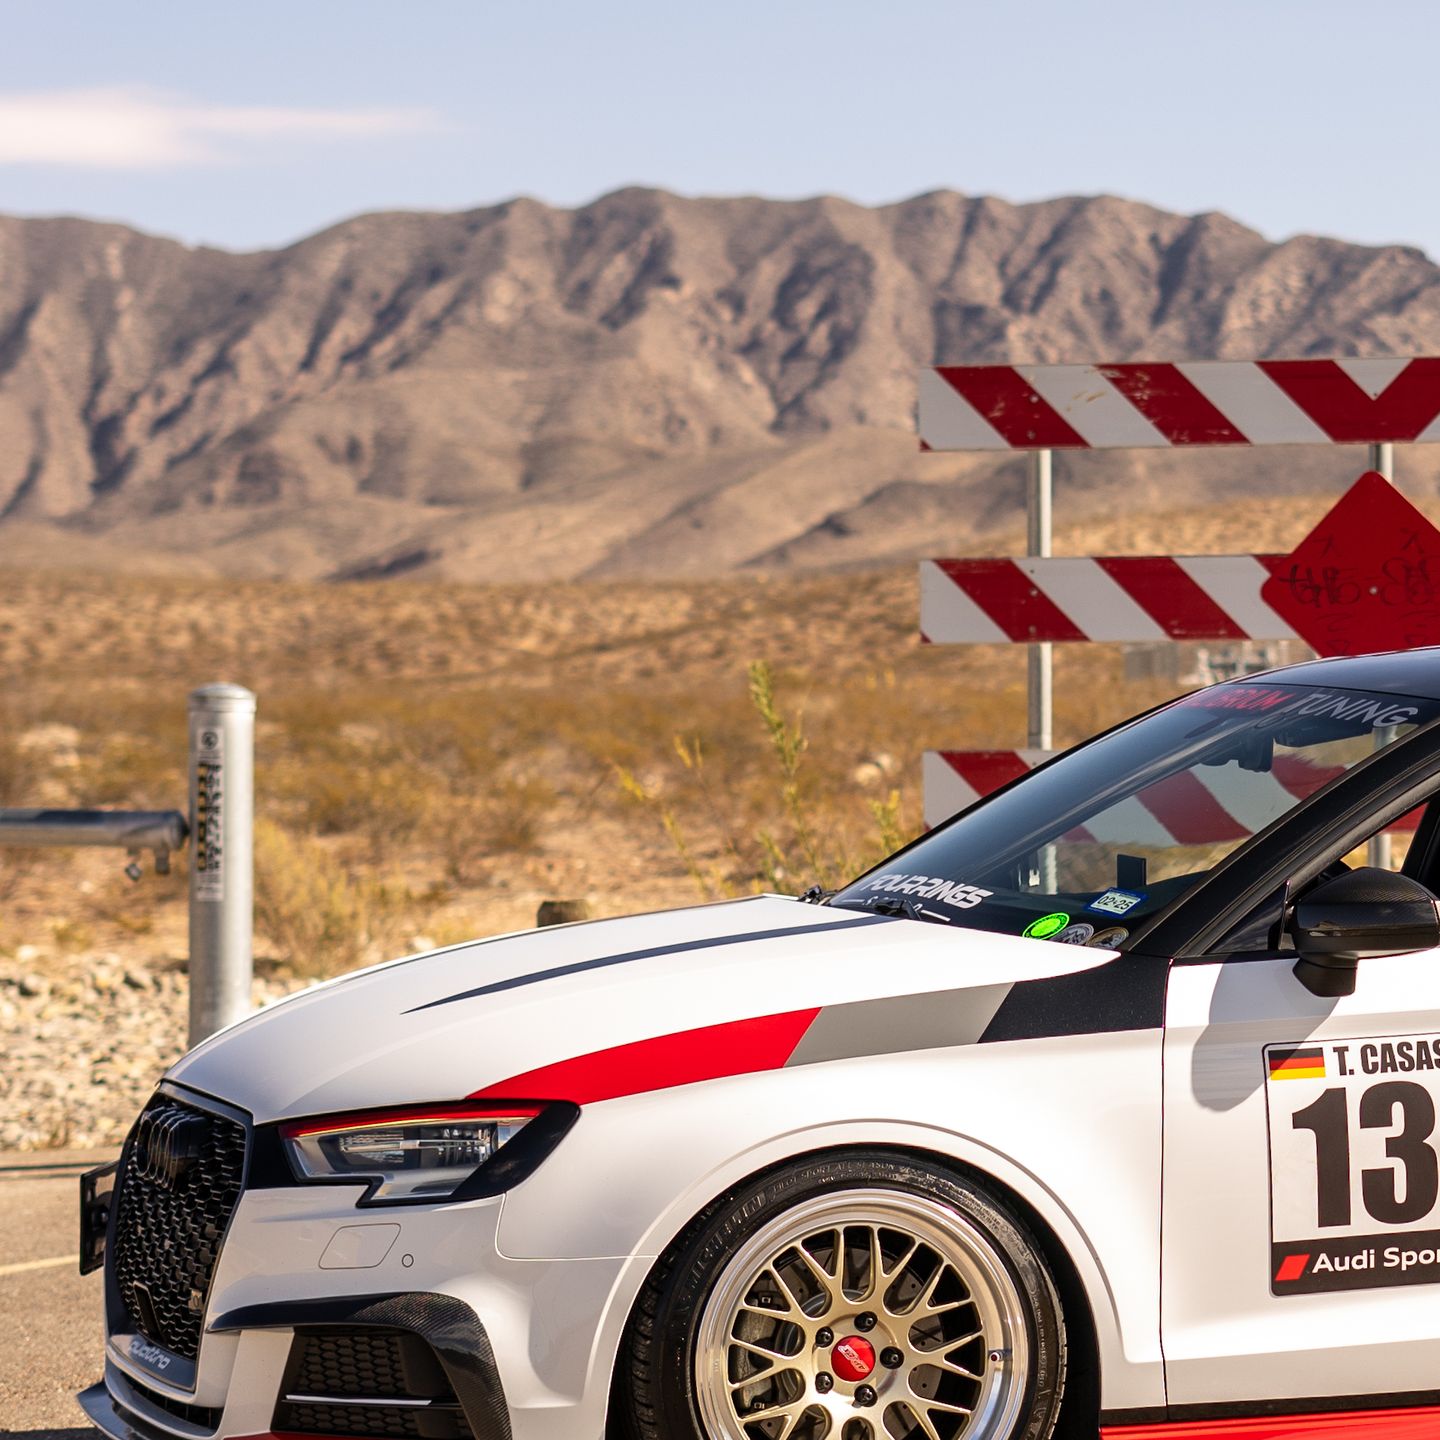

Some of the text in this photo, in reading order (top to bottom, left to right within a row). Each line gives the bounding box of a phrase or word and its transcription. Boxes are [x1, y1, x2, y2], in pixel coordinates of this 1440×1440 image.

[1298, 693, 1419, 728] TUNING
[860, 874, 994, 909] FOURRINGS
[1333, 1046, 1355, 1076] T.
[1291, 1080, 1439, 1228] 13
[1311, 1249, 1376, 1274] Audi
